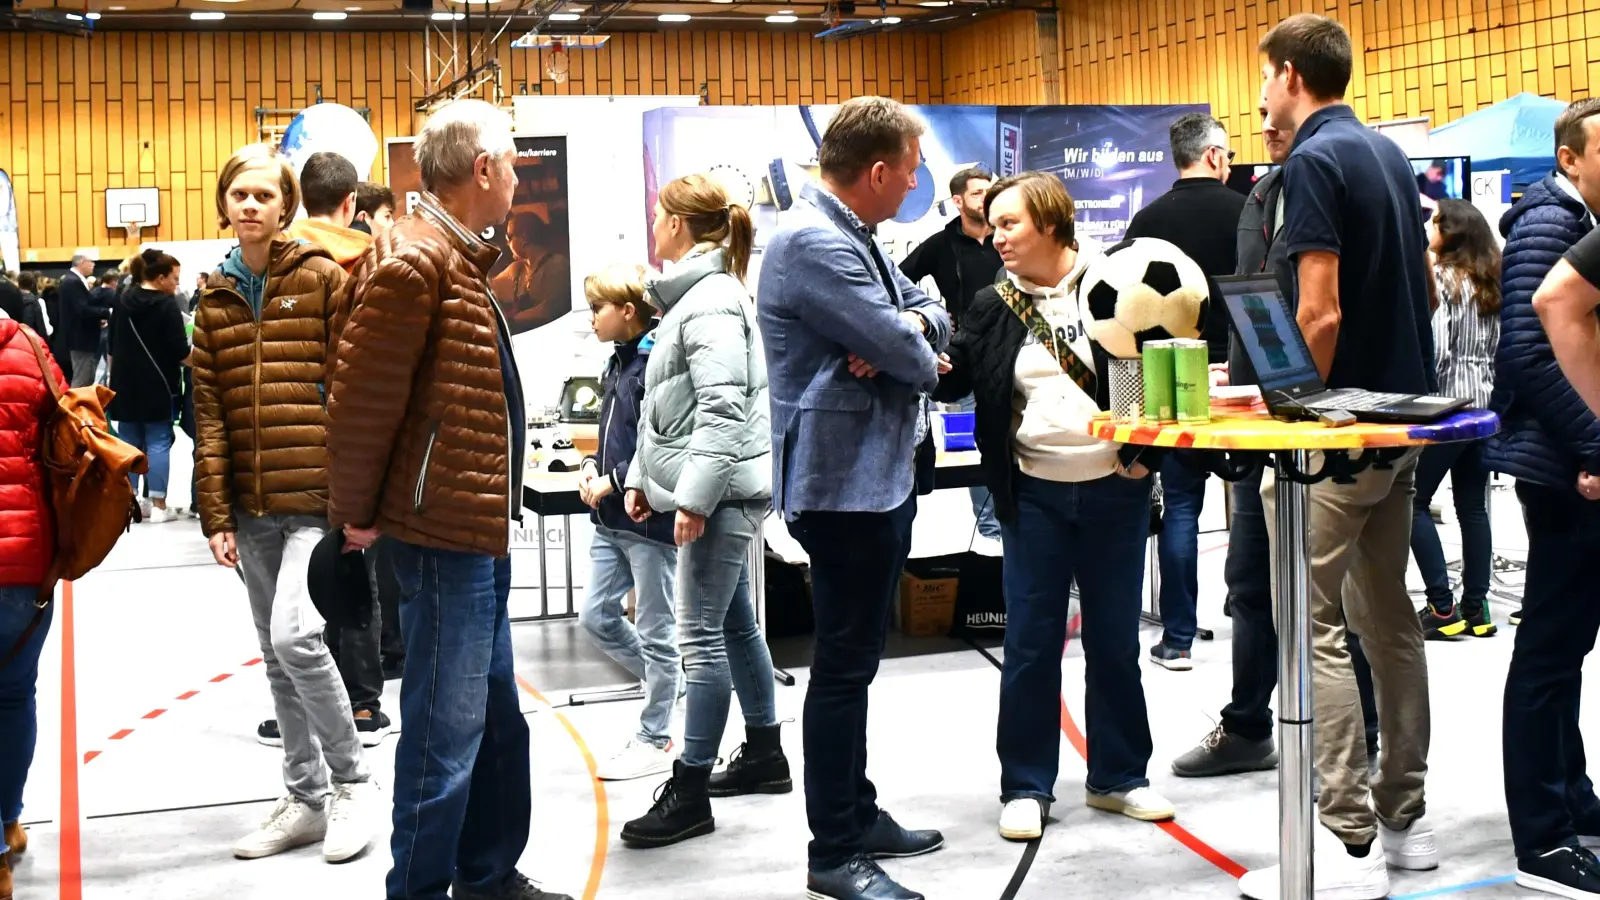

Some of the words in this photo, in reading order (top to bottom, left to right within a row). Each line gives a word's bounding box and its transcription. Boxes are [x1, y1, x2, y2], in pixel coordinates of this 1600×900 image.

[1063, 148, 1089, 163] Wir
[1091, 147, 1135, 163] bilden
[1138, 150, 1165, 162] aus
